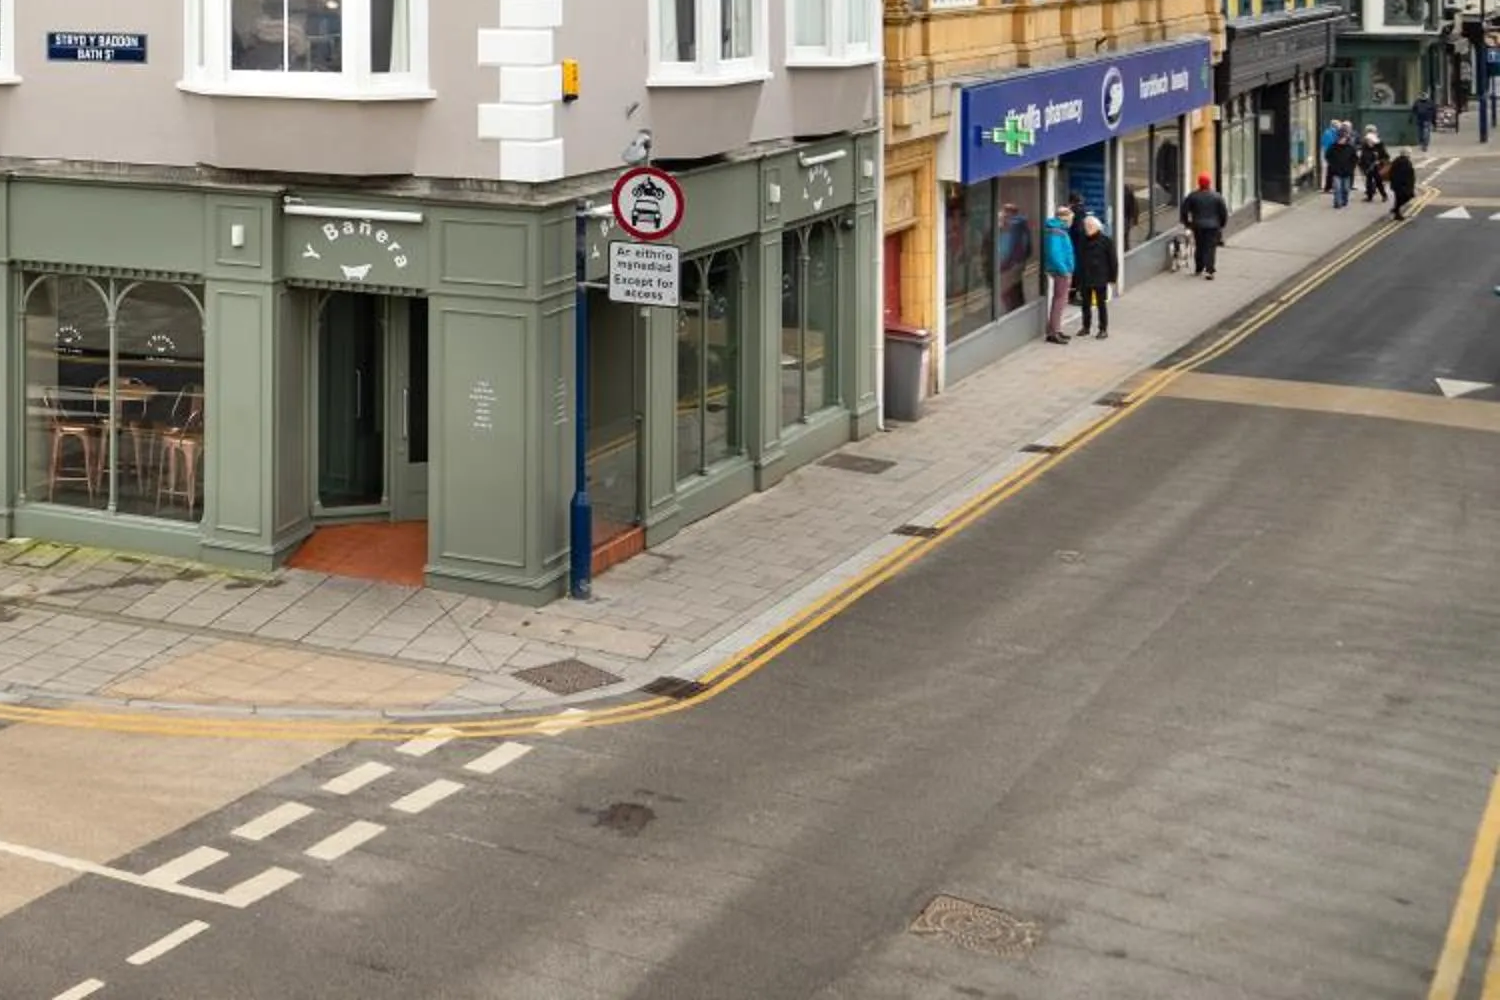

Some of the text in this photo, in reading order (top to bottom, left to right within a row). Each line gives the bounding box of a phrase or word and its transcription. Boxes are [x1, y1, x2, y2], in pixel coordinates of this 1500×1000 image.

[55, 34, 140, 47] STRYD Y BADDON
[77, 49, 116, 60] BATH ST
[1044, 98, 1083, 132] pharmacy
[301, 242, 321, 260] Y
[616, 247, 673, 261] Ar eithrio
[617, 260, 672, 273] mynediad
[614, 273, 674, 289] Except for
[624, 289, 663, 300] access
